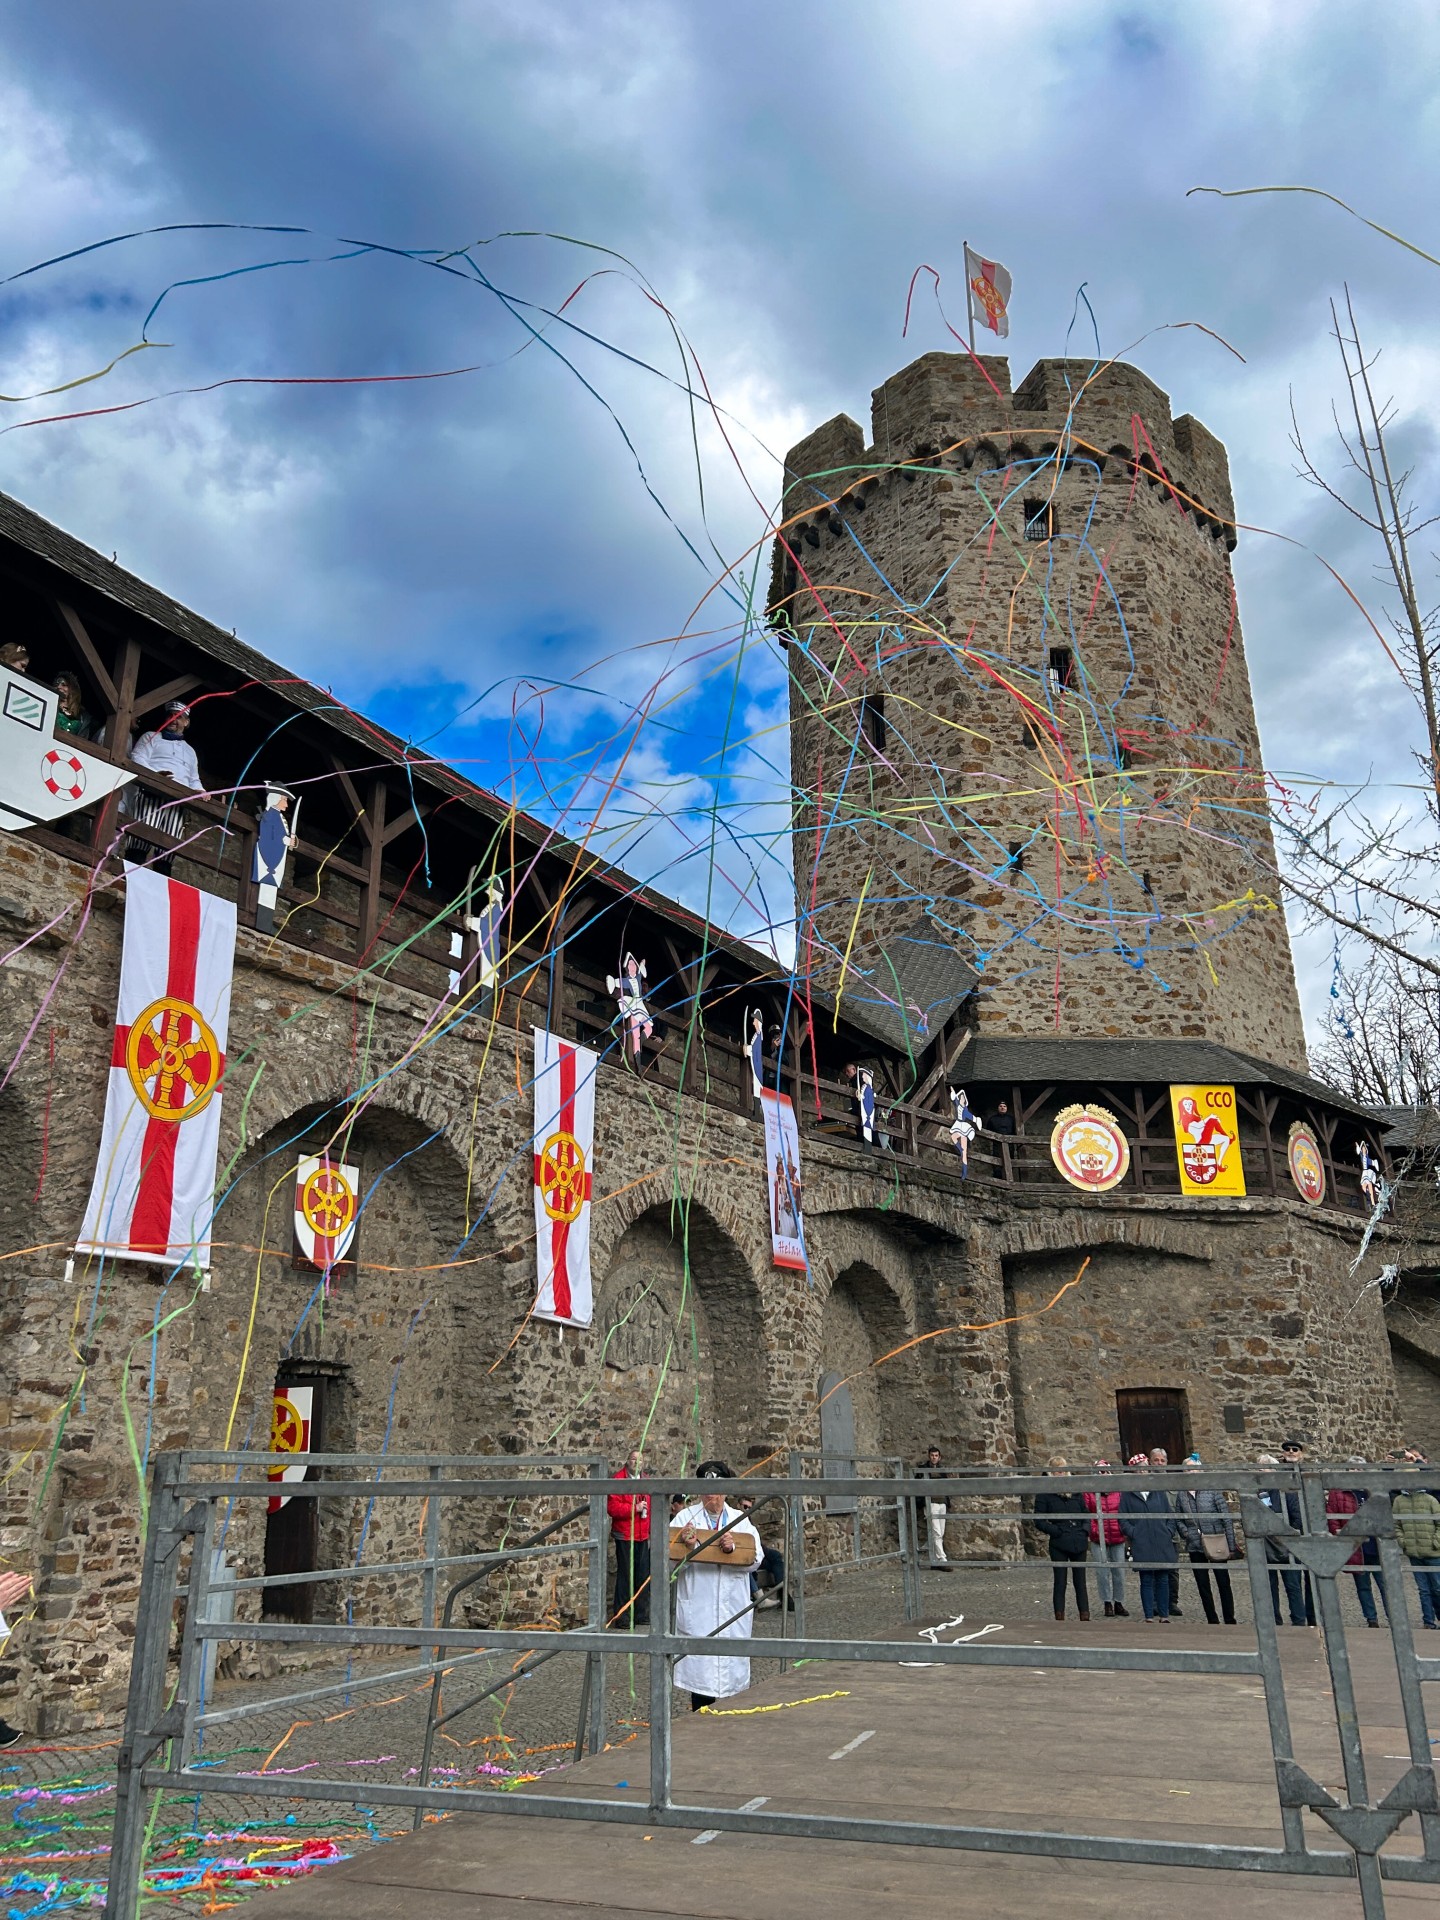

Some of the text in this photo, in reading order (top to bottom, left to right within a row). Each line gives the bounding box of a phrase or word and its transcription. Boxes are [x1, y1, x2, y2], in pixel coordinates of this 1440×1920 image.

[1206, 1092, 1232, 1107] CCO
[1186, 1165, 1202, 1182] CCO
[778, 1241, 801, 1257] Helau
